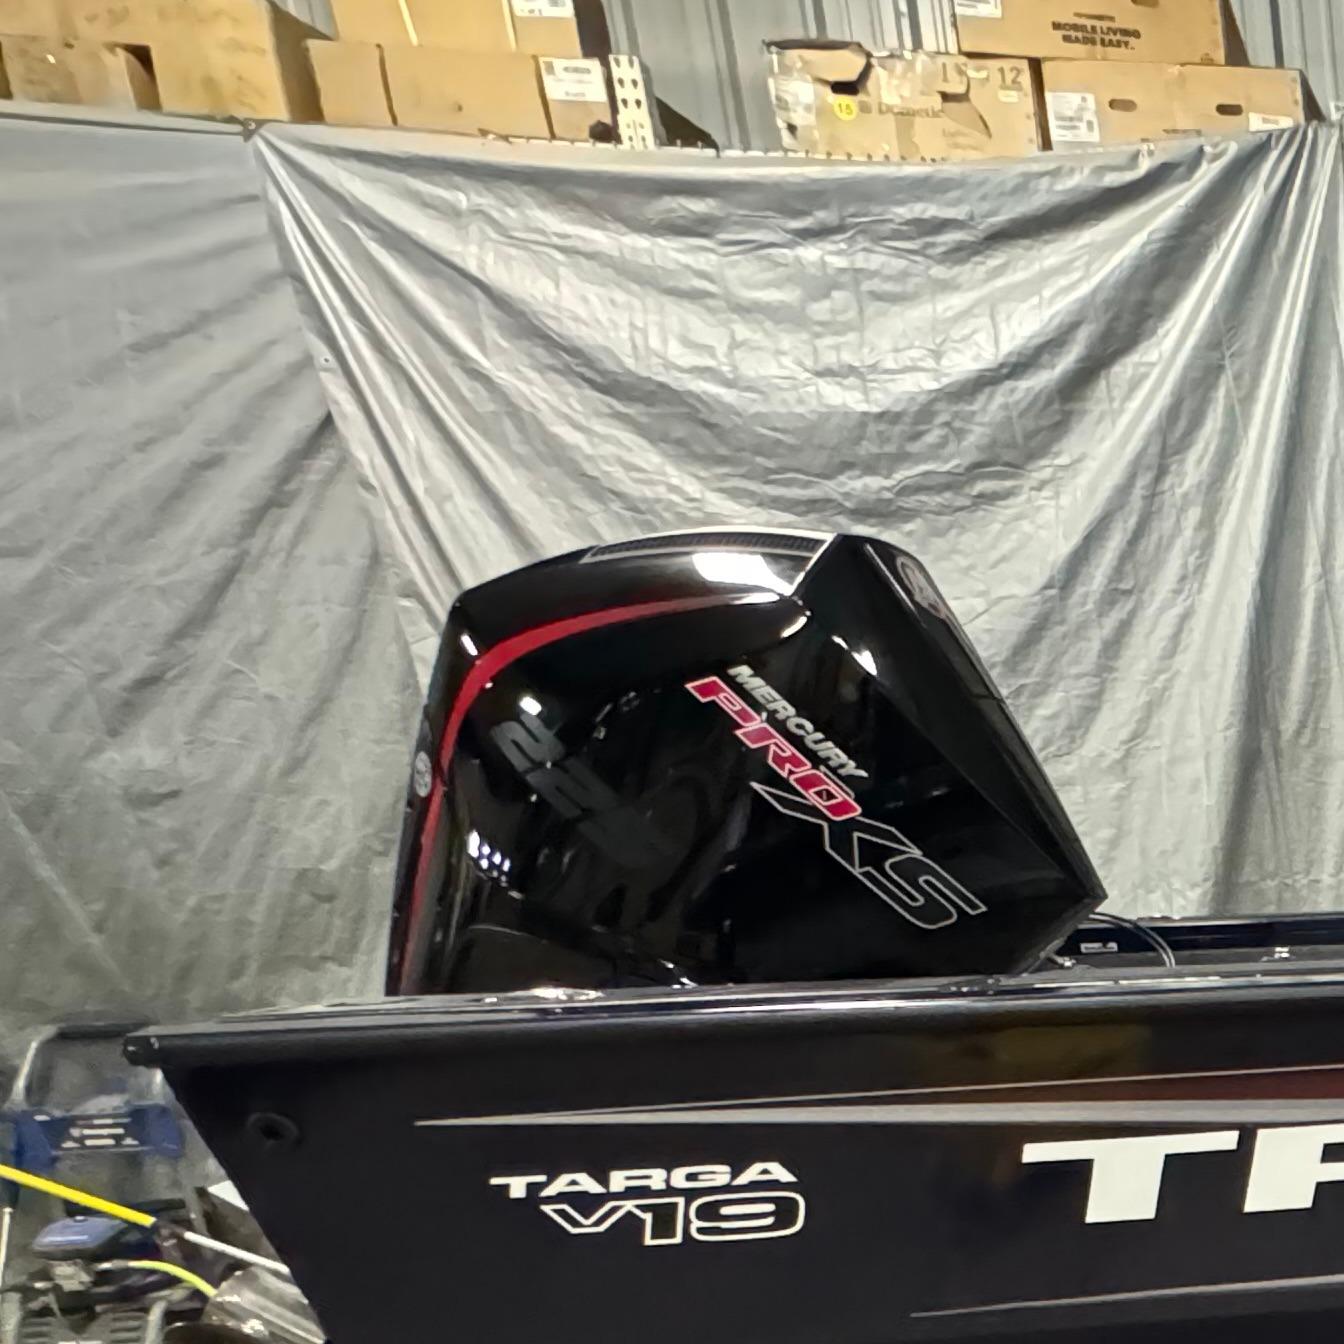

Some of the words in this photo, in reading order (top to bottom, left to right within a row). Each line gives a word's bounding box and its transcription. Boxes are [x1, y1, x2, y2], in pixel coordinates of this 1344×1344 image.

[685, 676, 862, 820] PRO
[727, 665, 869, 779] MERCURY
[750, 765, 988, 929] XS
[489, 1161, 798, 1200] TARGA
[539, 1190, 806, 1247] V19
